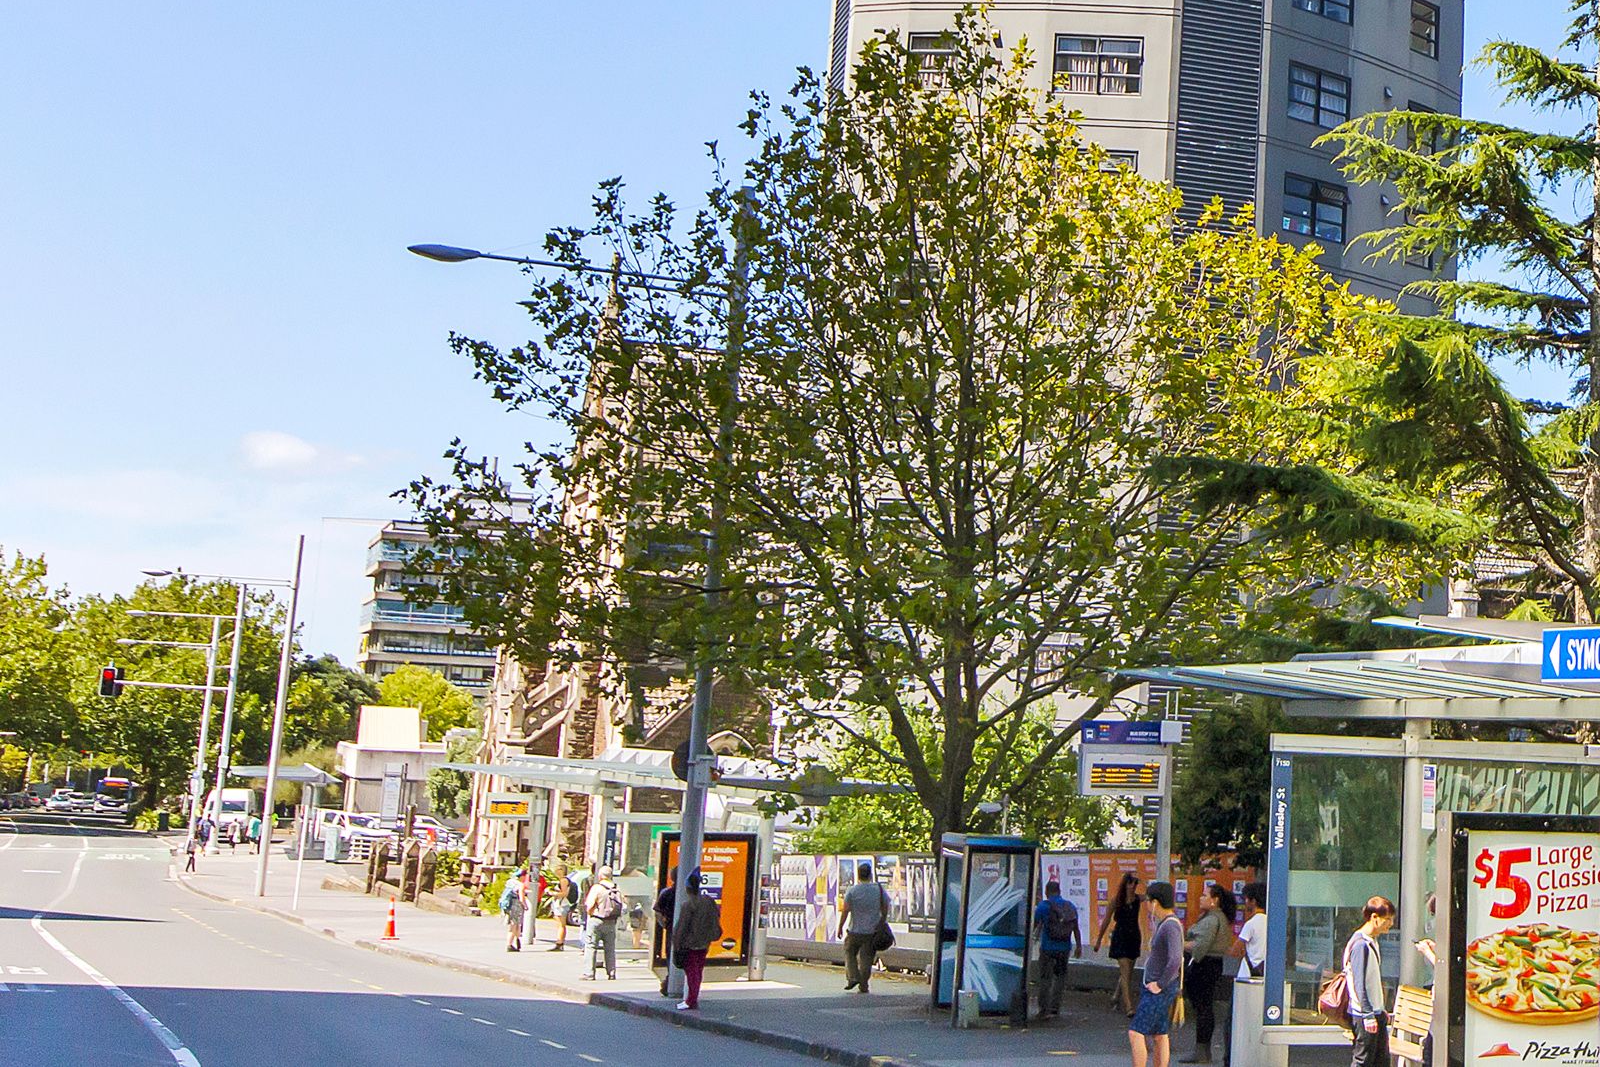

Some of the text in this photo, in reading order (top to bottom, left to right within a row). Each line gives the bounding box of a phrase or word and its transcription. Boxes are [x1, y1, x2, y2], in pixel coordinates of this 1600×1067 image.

[1275, 787, 1287, 849] Wellesley St
[1537, 845, 1593, 869] Large
[1472, 847, 1532, 919] $5
[1537, 892, 1588, 914] Pizza
[1522, 1041, 1571, 1061] Pizza
